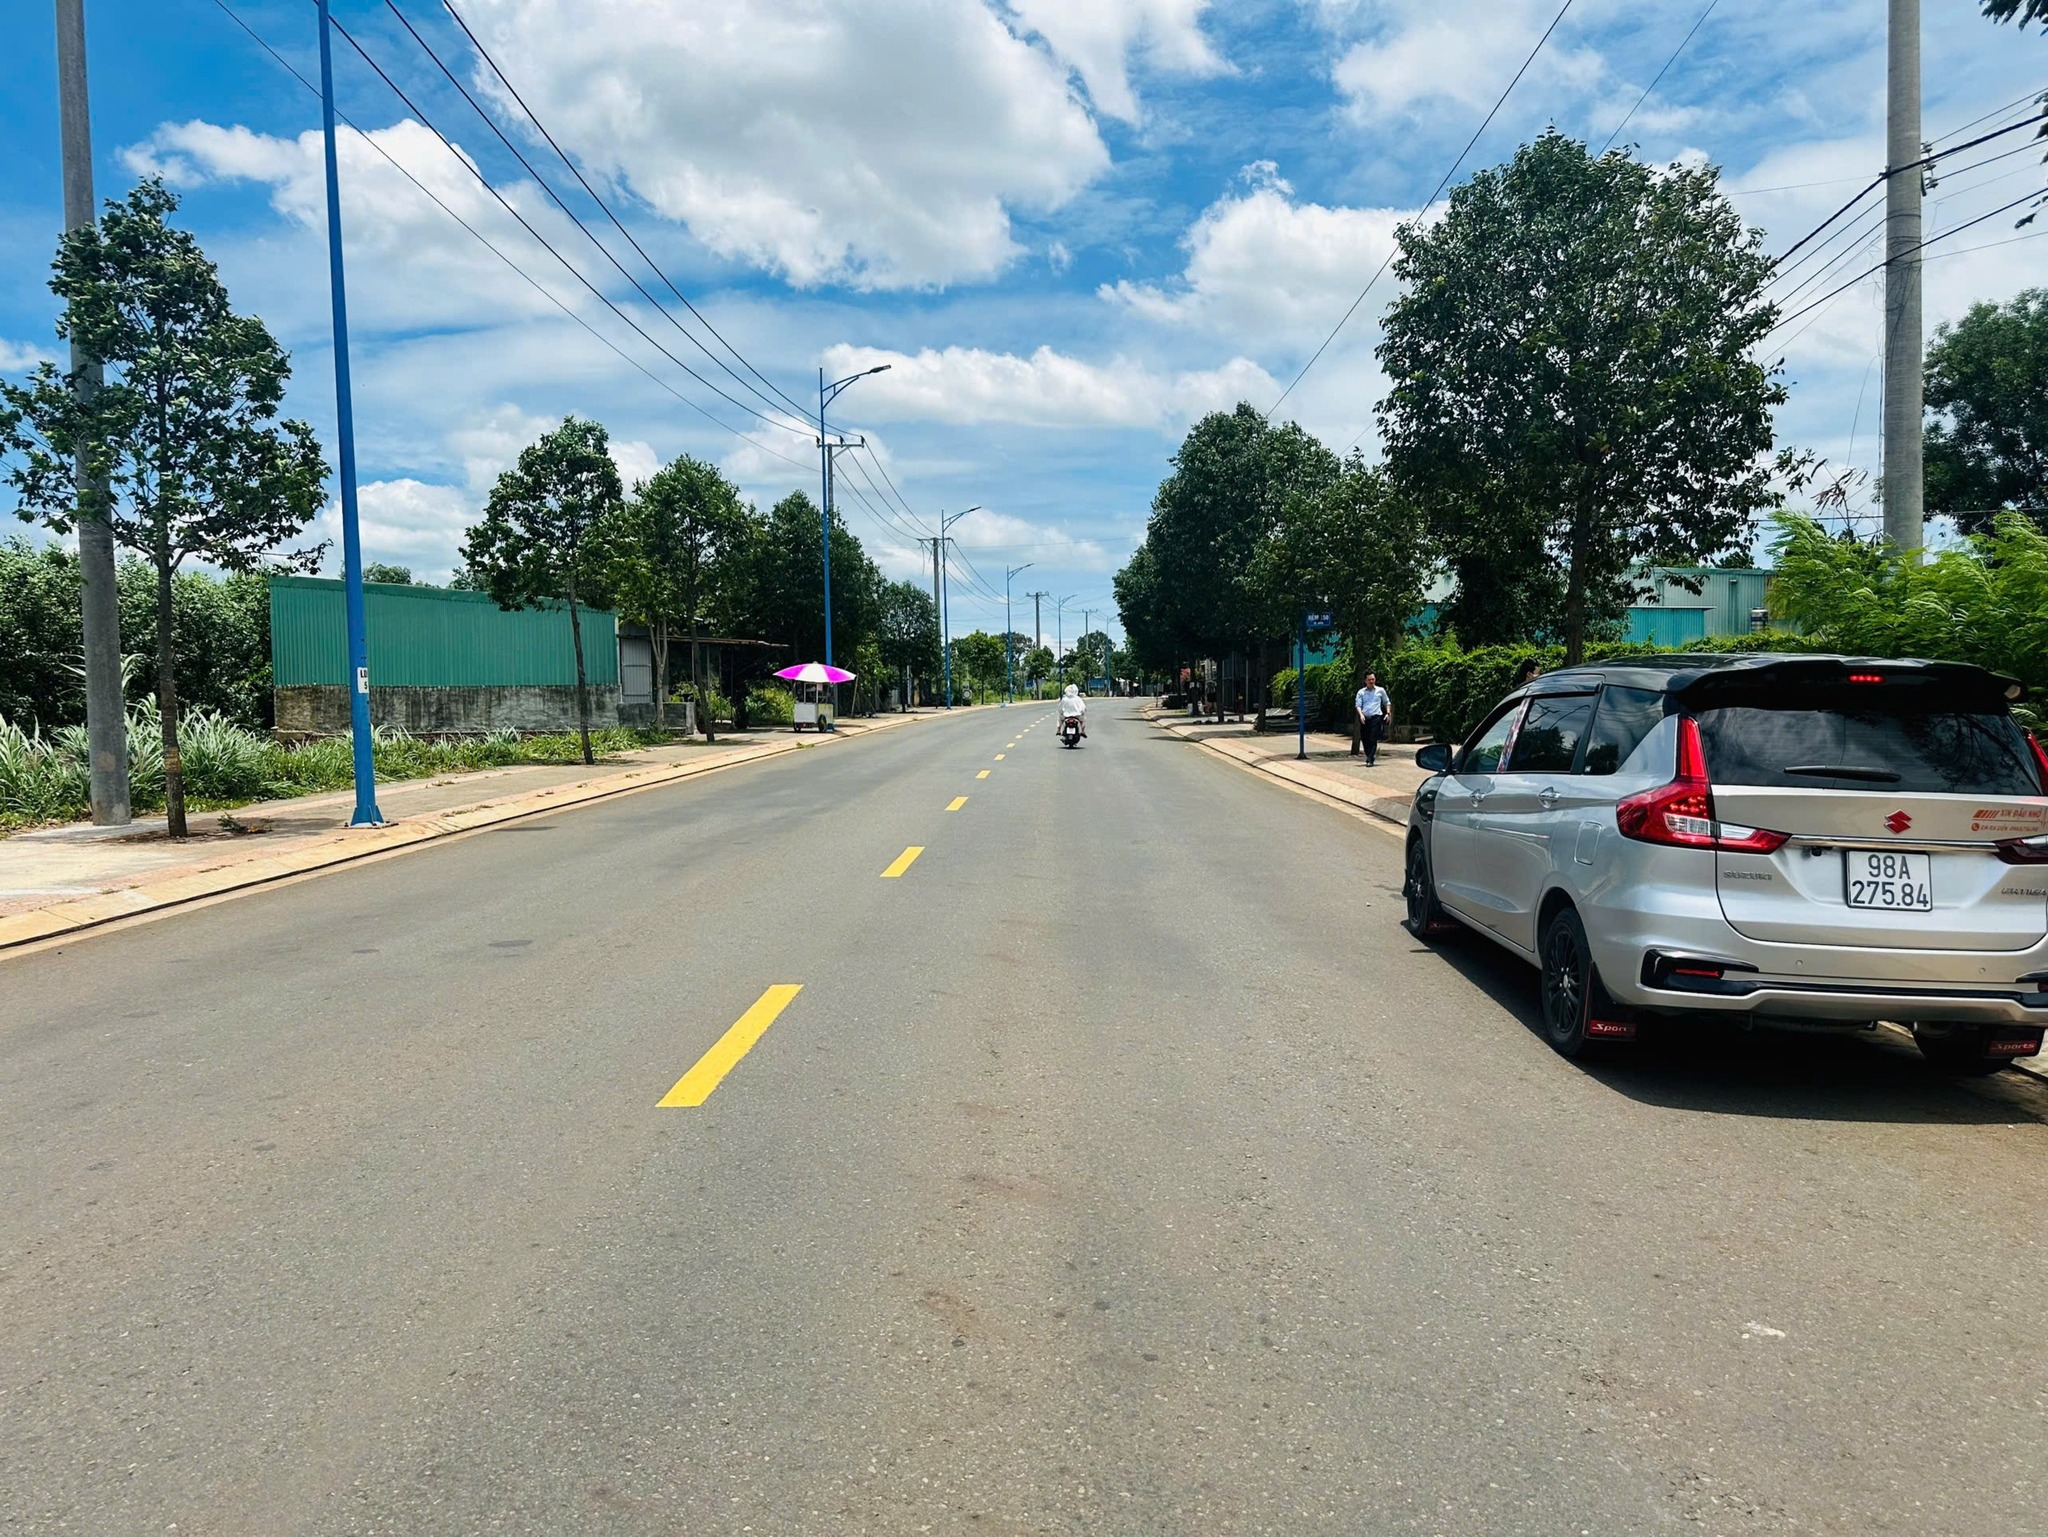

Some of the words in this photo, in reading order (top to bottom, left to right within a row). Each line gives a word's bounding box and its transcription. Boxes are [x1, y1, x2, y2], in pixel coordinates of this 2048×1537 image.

[1723, 870, 1773, 881] SUZUKI
[1868, 854, 1911, 880] 98A
[1852, 880, 1929, 908] 275.84
